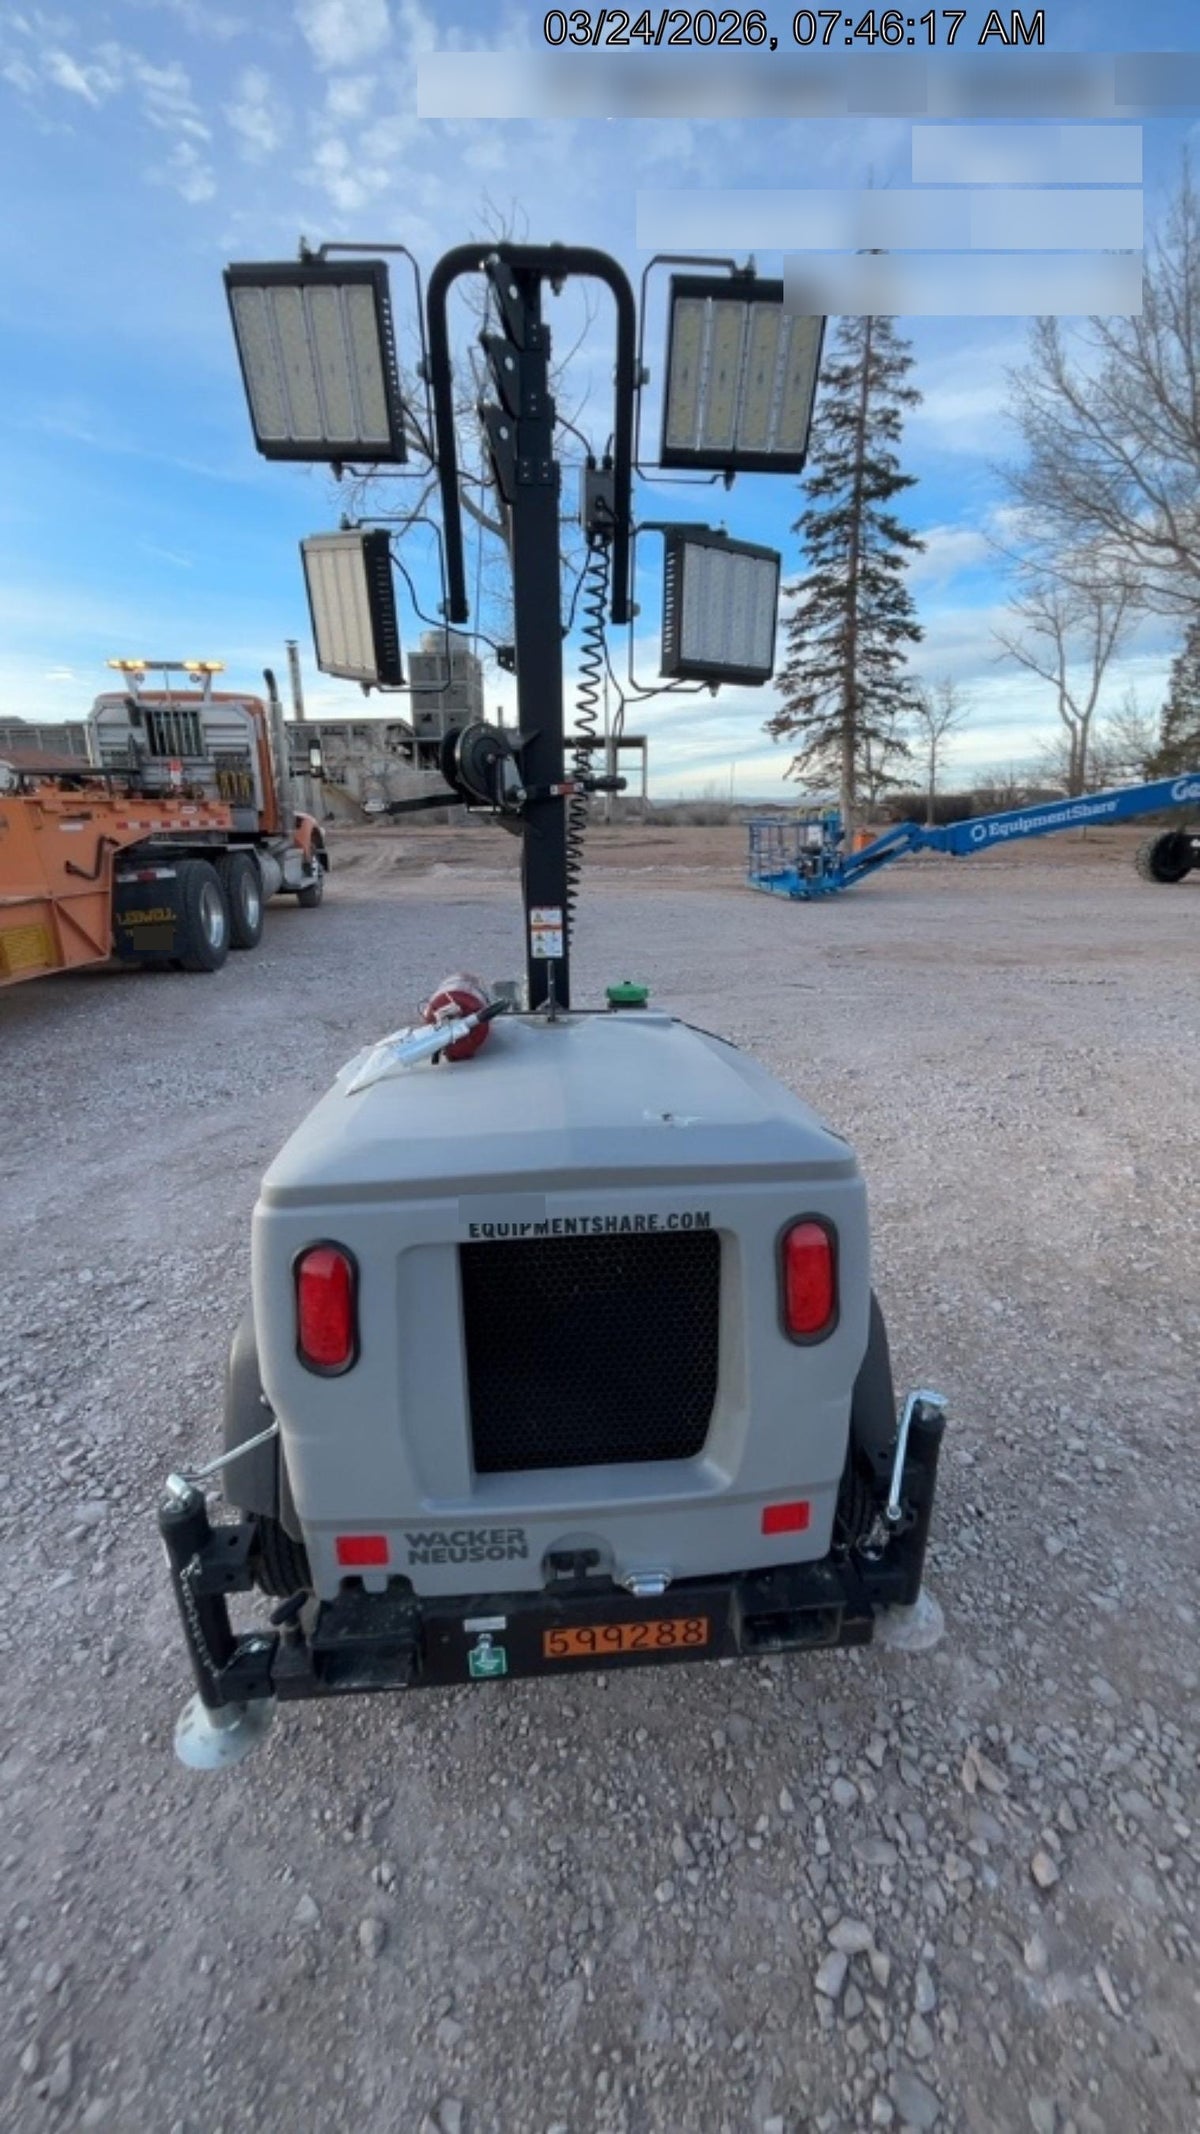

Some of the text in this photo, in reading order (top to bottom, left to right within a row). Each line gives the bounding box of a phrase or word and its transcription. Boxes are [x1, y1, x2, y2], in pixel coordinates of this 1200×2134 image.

[989, 801, 1117, 837] EquipmentShare
[469, 1211, 711, 1239] EQUIPMENTSHARE.COM
[405, 1528, 527, 1548] WACKER
[408, 1545, 529, 1565] NEUSON
[549, 1620, 703, 1655] 599288
